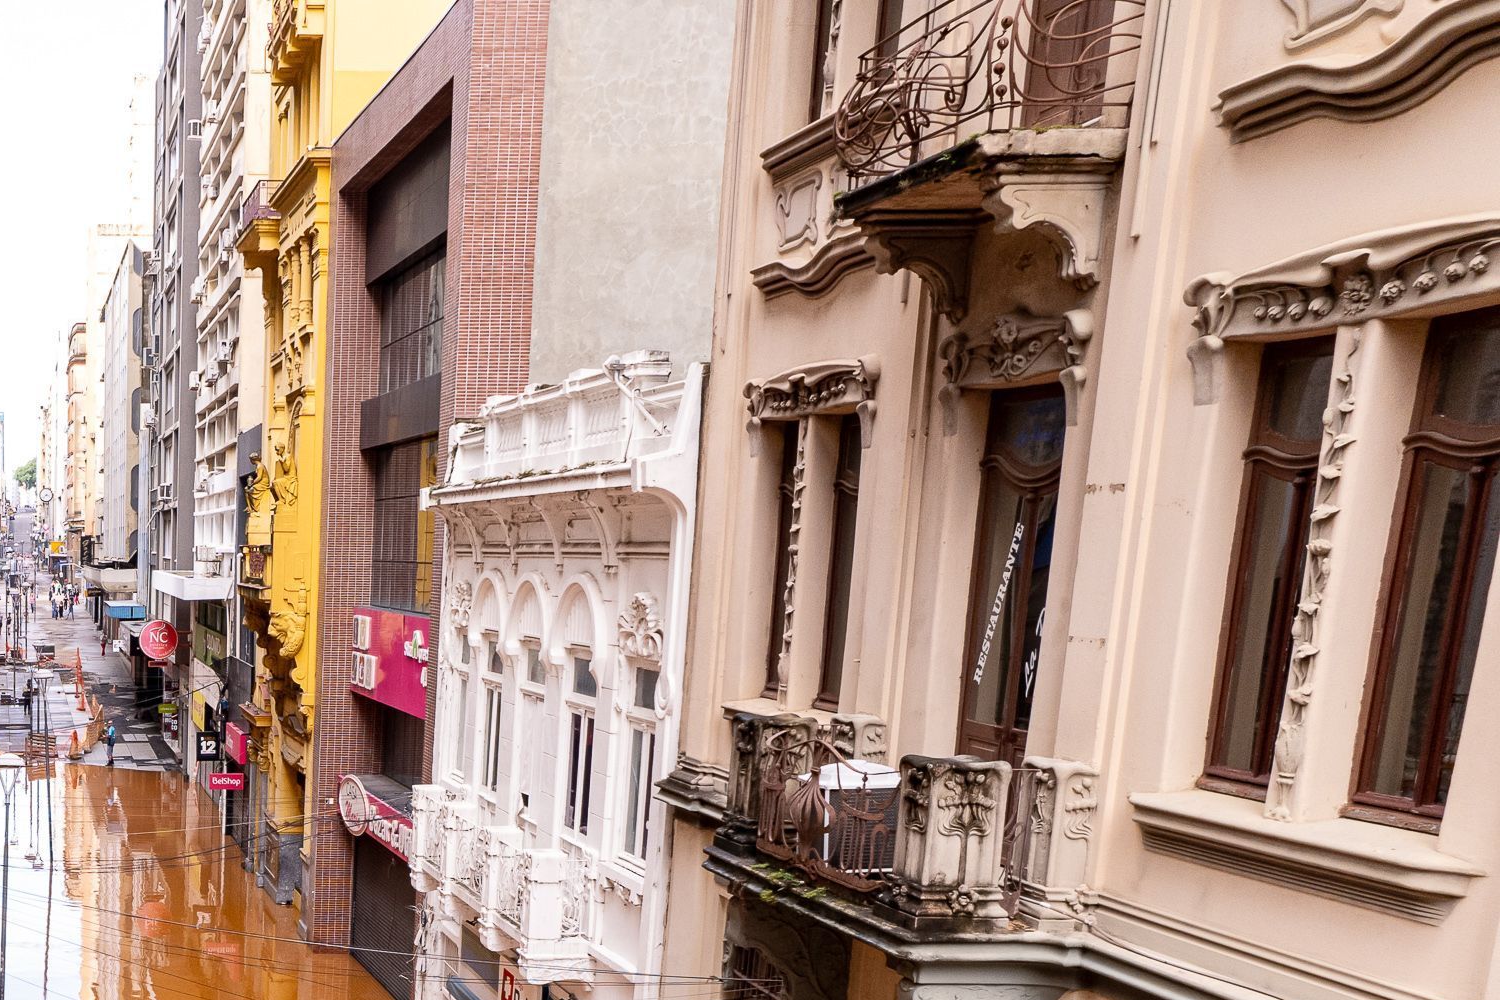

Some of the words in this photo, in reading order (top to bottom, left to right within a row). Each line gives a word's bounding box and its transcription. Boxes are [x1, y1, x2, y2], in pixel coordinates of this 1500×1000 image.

[973, 522, 1025, 686] RESTAURANTE
[149, 631, 168, 643] NC
[201, 740, 216, 751] 12
[212, 776, 241, 787] BelShop
